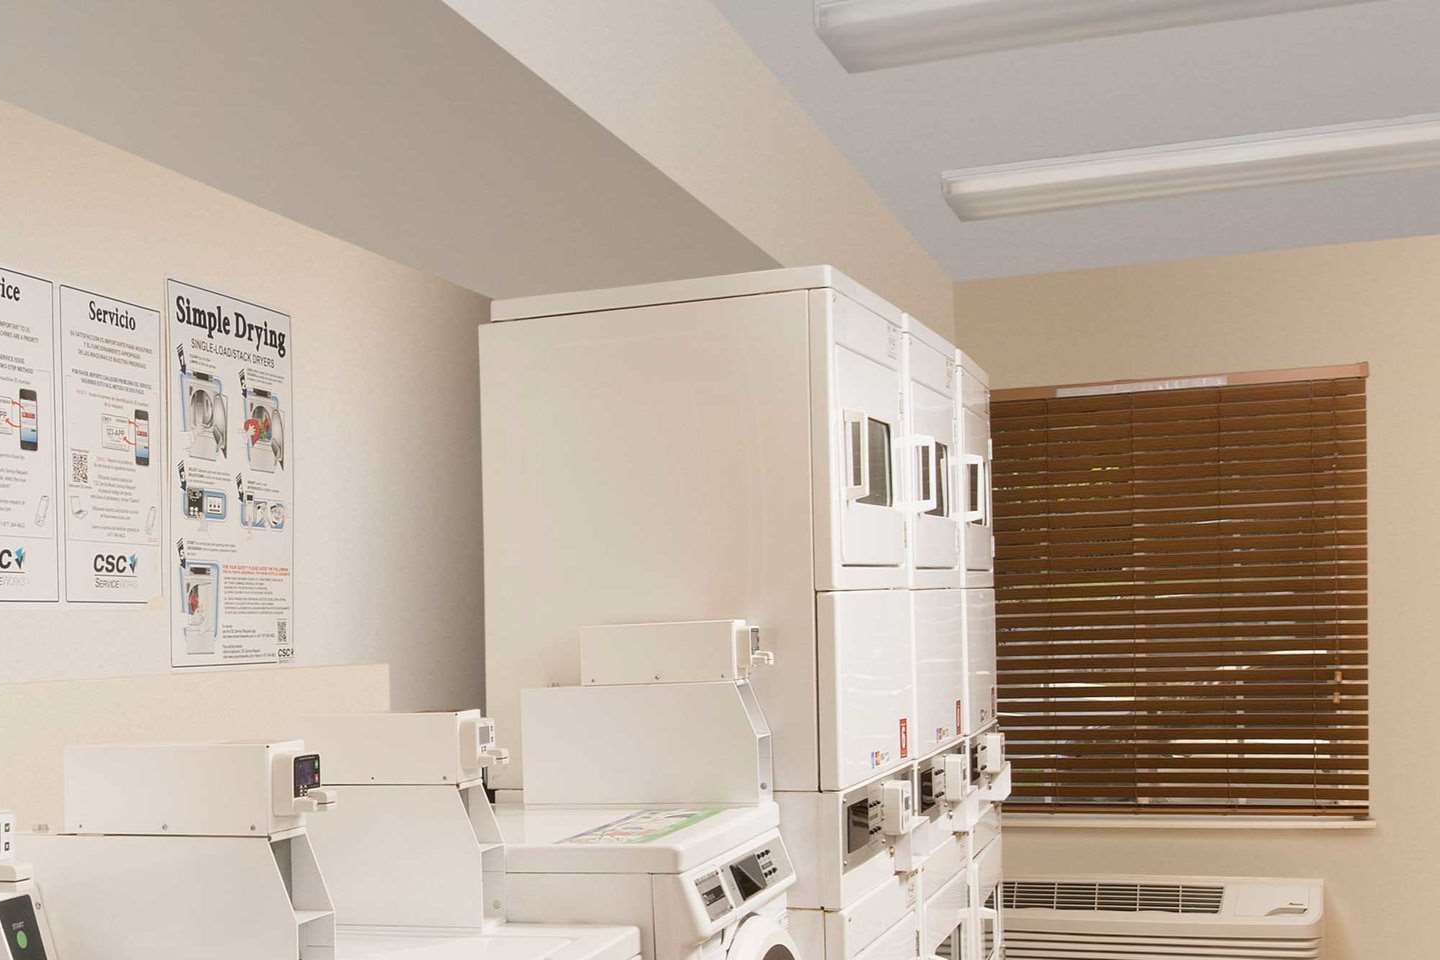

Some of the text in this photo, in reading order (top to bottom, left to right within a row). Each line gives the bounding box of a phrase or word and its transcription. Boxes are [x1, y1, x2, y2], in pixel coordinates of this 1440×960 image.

[89, 300, 136, 330] Servicio
[176, 295, 286, 358] Simple Drying
[252, 353, 275, 368] DRYERS
[93, 554, 127, 573] CSC
[277, 648, 290, 657] CSC
